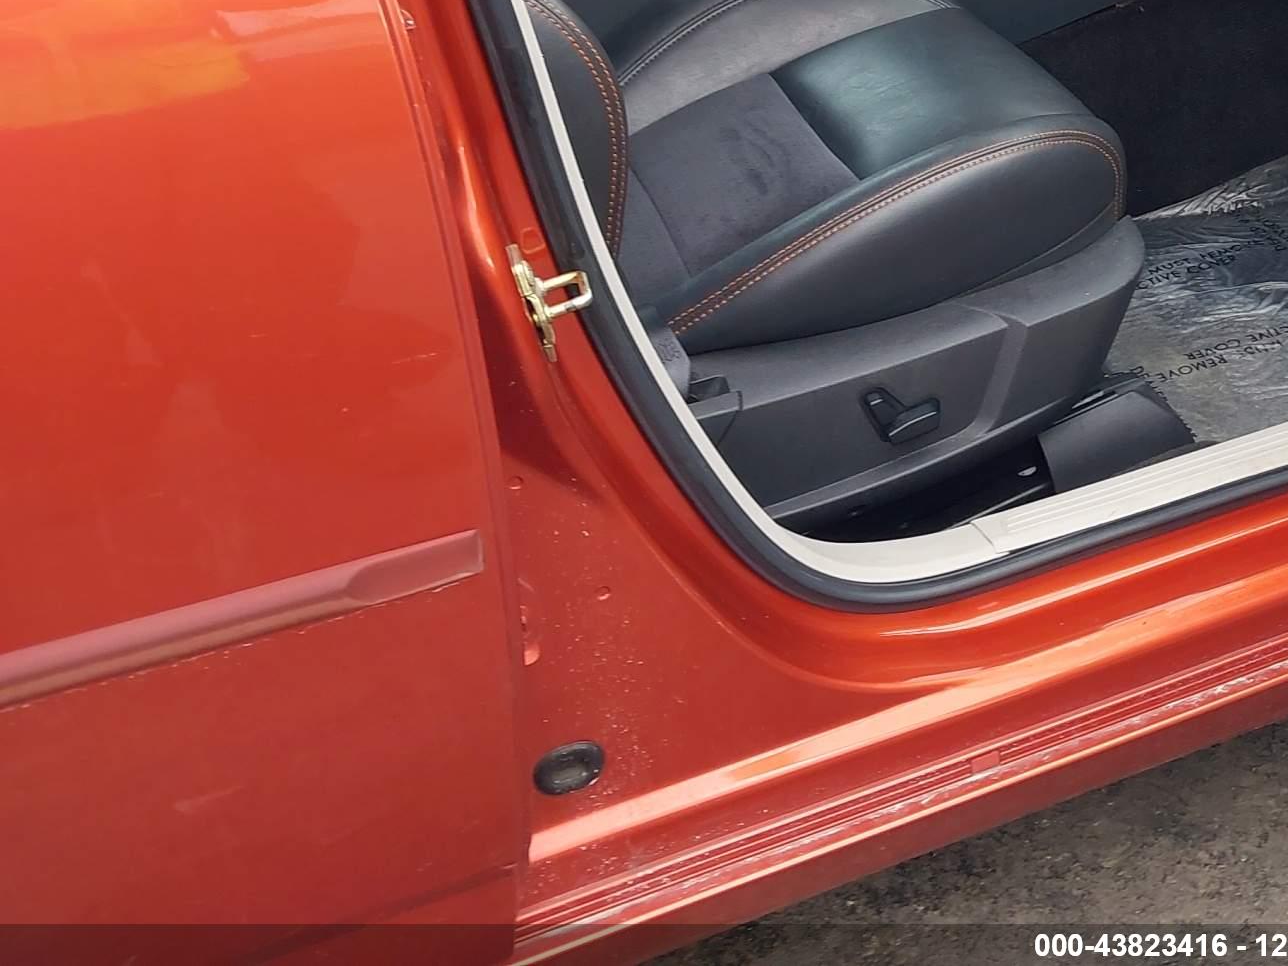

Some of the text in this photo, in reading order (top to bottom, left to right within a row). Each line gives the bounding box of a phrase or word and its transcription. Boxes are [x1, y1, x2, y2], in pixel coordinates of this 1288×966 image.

[1148, 257, 1191, 275] MUST
[1187, 254, 1236, 274] COVER
[1184, 338, 1242, 361] COVER
[1155, 353, 1229, 384] REMOVE
